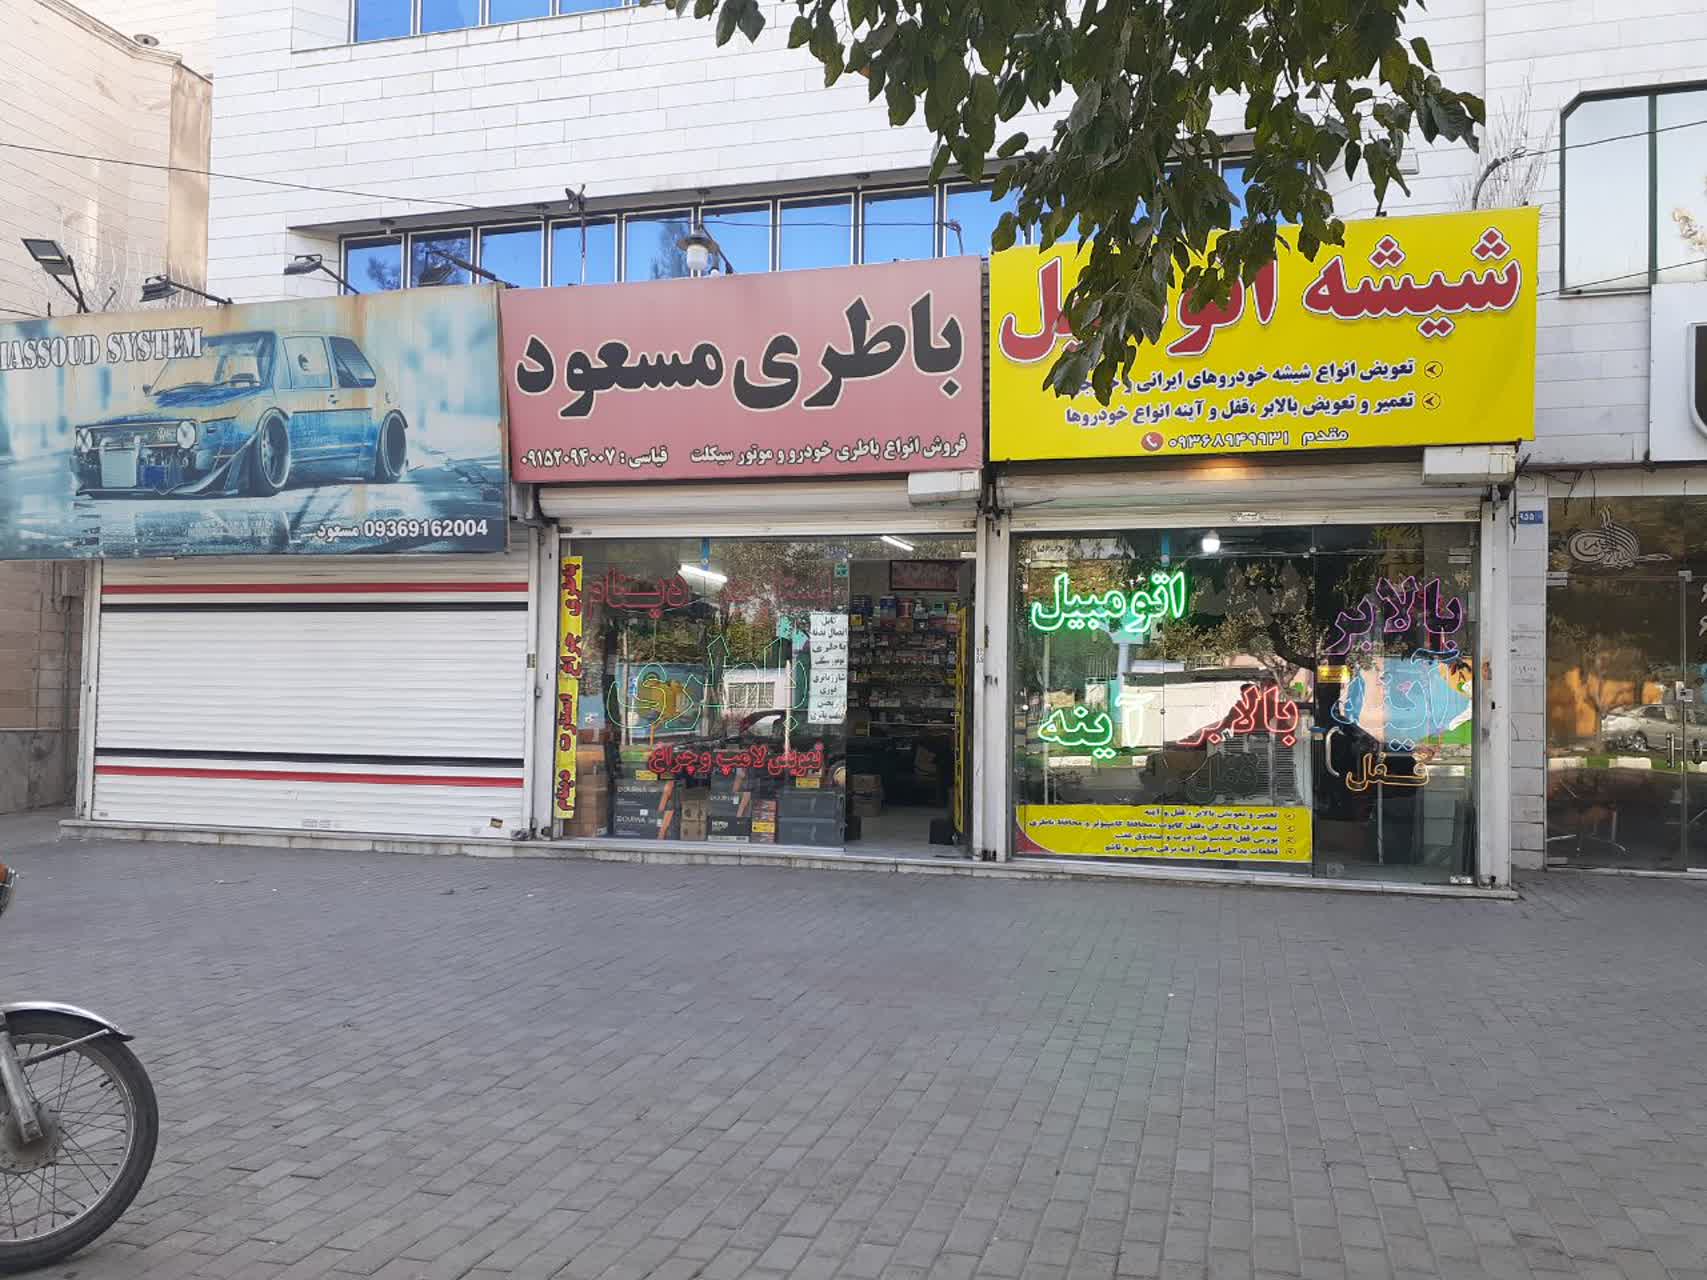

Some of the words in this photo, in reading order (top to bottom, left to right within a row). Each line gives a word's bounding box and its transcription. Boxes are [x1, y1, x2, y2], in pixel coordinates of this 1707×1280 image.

[1301, 236, 1520, 337] شیشه
[106, 327, 203, 364] SYSTEM
[734, 292, 963, 411] باطری
[517, 336, 724, 419] مسعود
[1186, 371, 1268, 390] خودروهای
[1272, 366, 1311, 382] شیشه
[1315, 362, 1356, 384] انواع
[1360, 360, 1414, 381] تعویض
[1136, 372, 1183, 392] ایرانی
[1133, 405, 1170, 424] انواع
[1173, 400, 1203, 420] آینه
[1208, 407, 1218, 421] و
[1260, 397, 1298, 418] بالابر
[1301, 395, 1355, 416] تعویض
[1359, 400, 1369, 414] و
[1374, 393, 1414, 414] تعمیر
[1066, 407, 1128, 428] خودروها
[882, 435, 919, 460] انواع
[922, 432, 968, 458] فروش
[1301, 427, 1349, 447] مقدم
[690, 443, 733, 464] سیکلت
[736, 444, 773, 465] موتور
[776, 449, 786, 464] و
[787, 441, 832, 463] خودرو
[835, 438, 880, 461] باطری
[316, 525, 360, 544] مسعود
[363, 518, 489, 538] 09369162004
[1031, 571, 1185, 632] اتومبیل
[1323, 576, 1463, 656] بالابر
[606, 635, 811, 734] باطری
[1331, 648, 1461, 753] آینه
[1176, 685, 1299, 746] بالابر
[1038, 694, 1152, 760] آینه
[649, 742, 697, 776] چراغ
[715, 745, 767, 777] لامپ
[768, 740, 823, 777] تعویض
[1344, 751, 1429, 792] قفل
